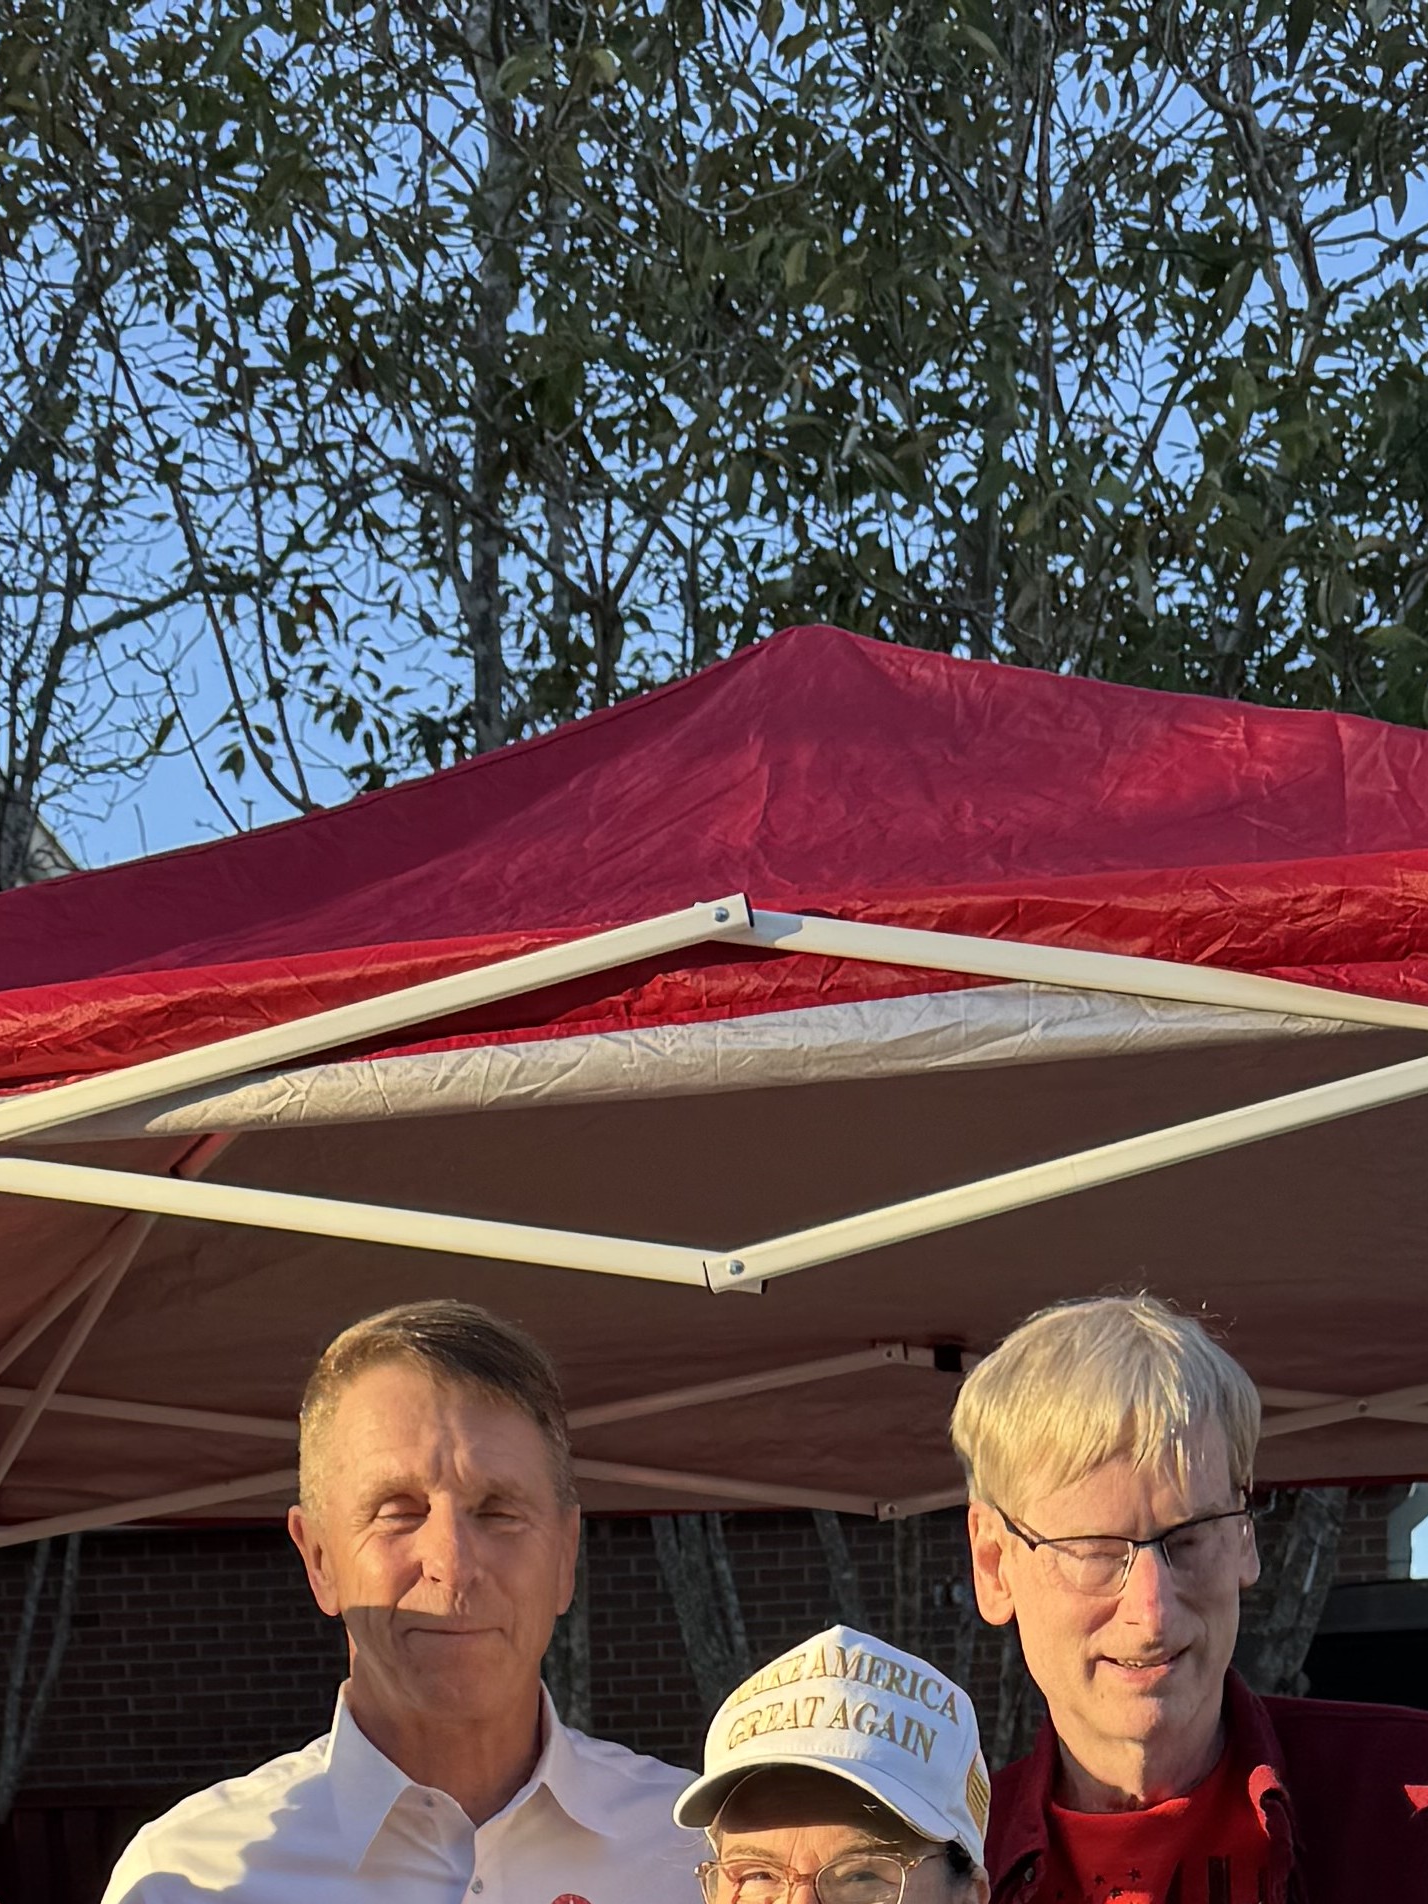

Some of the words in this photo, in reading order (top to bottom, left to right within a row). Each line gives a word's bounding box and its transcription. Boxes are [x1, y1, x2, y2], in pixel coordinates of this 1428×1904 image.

[809, 1645, 959, 1726] AMERICA
[728, 1696, 824, 1750] GREAT
[826, 1697, 938, 1763] AGAIN
